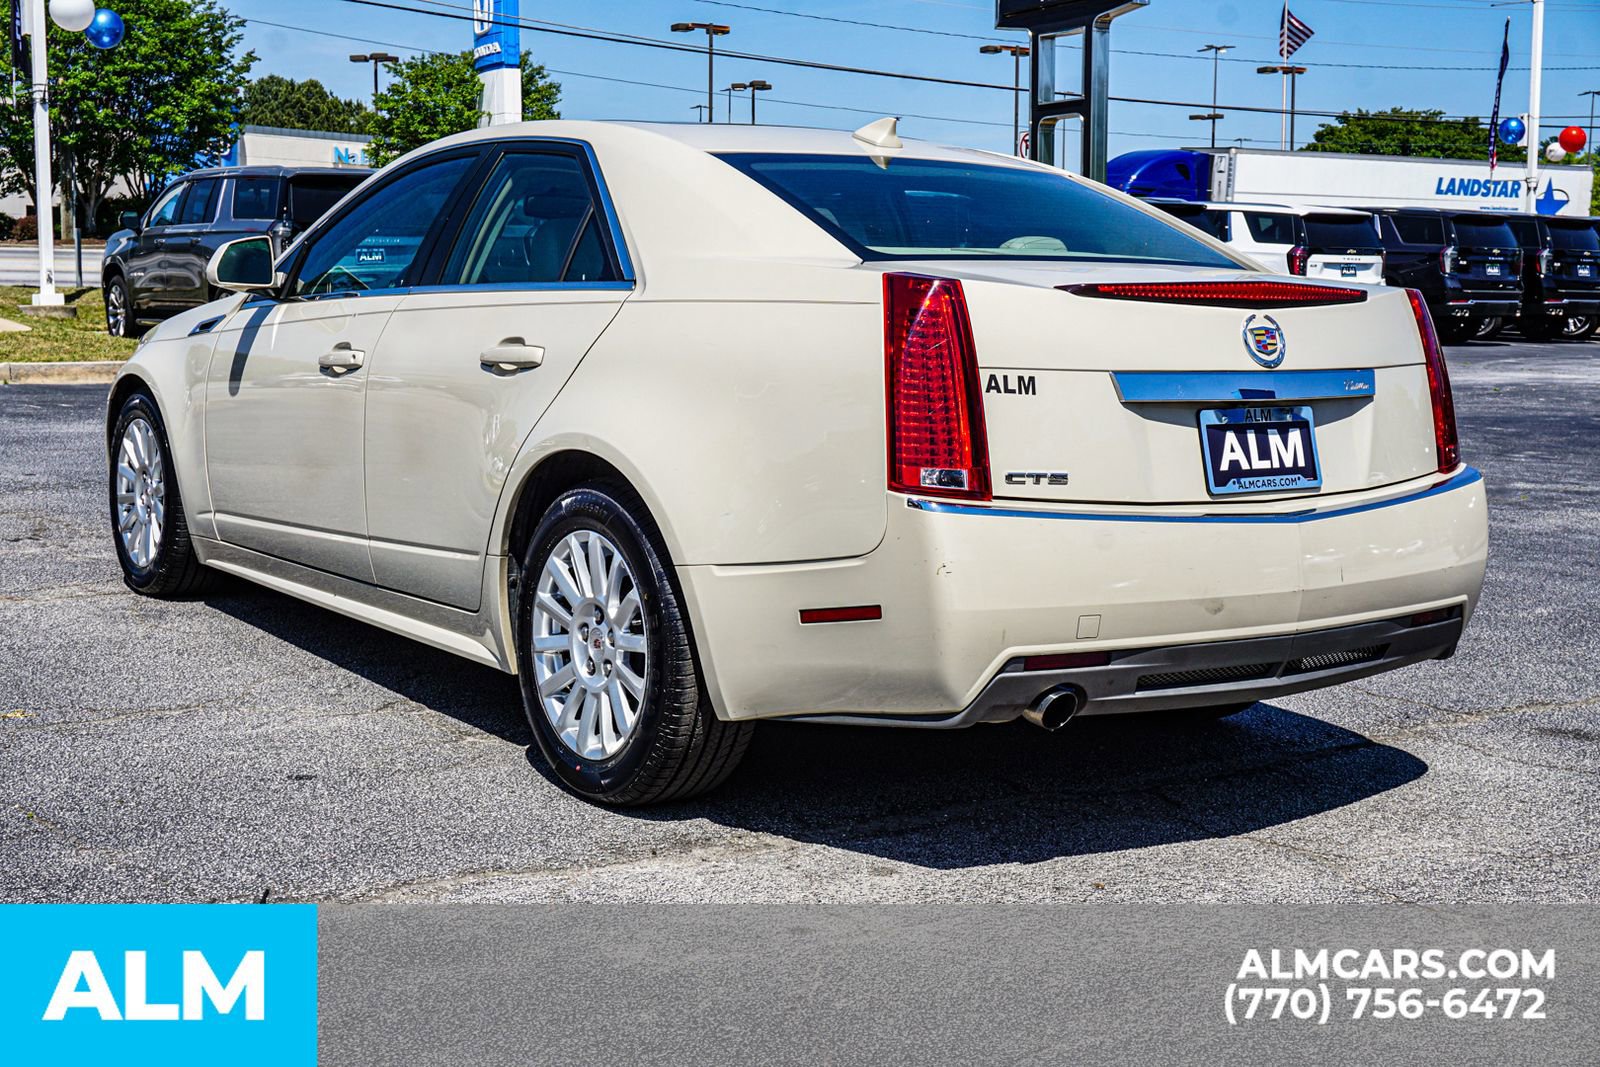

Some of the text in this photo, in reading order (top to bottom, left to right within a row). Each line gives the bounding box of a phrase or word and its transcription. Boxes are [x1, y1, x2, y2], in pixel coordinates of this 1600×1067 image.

[1435, 177, 1522, 198] LANDSTAR
[985, 374, 1037, 395] ALM
[1245, 407, 1273, 423] ALM
[1219, 427, 1306, 471] ALM
[1005, 471, 1069, 485] CTS
[1237, 475, 1298, 490] ALMCARS.COM
